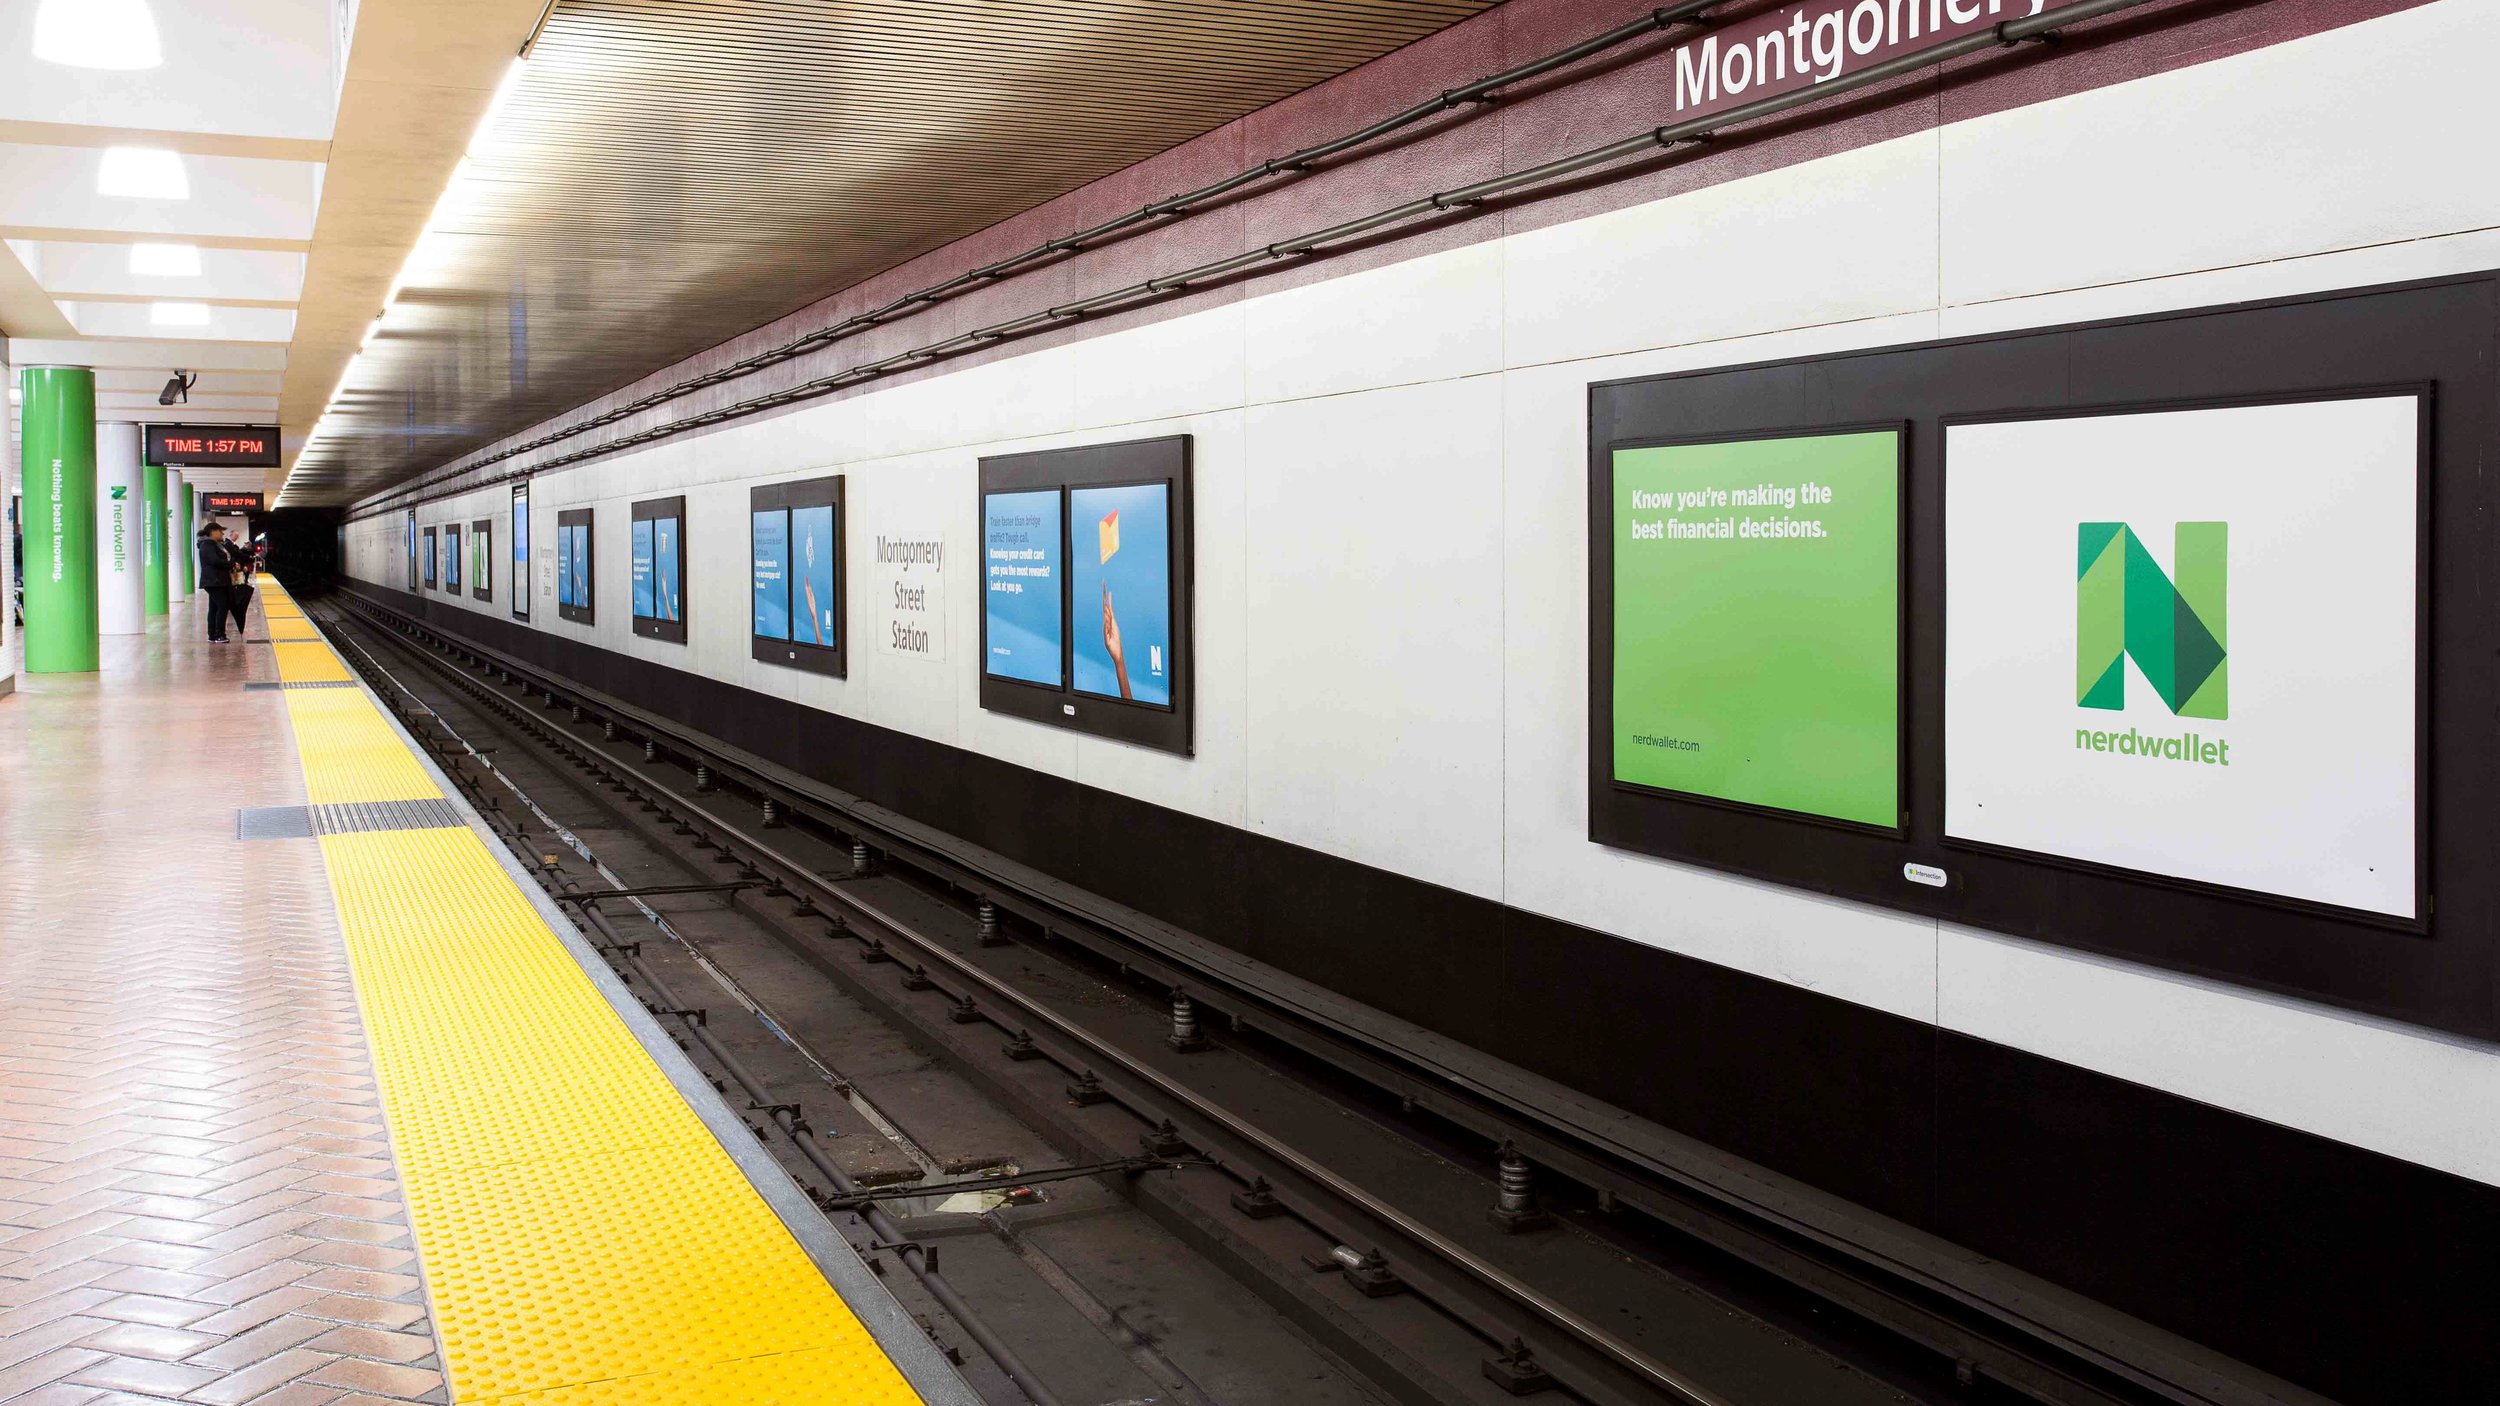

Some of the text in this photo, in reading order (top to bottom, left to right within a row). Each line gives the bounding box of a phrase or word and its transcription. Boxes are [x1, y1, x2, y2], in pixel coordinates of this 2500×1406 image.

[1675, 0, 2045, 111] Montgom
[164, 439, 263, 453] TIME 1:57 PM
[211, 498, 228, 506] TIME
[1632, 481, 1832, 512] Know you're making the
[51, 459, 64, 583] Nothing beats knowing.
[1632, 516, 1827, 540] best financial decisions.
[113, 504, 126, 572] nerdwallet
[877, 535, 943, 573] Montgomery
[1034, 548, 1045, 560] card
[894, 580, 925, 612] Street
[892, 620, 929, 654] Station
[2077, 521, 2229, 721] N
[1150, 646, 1162, 670] N
[1632, 734, 1700, 752] nerdwallet.com
[2076, 727, 2230, 767] nerdwallet
